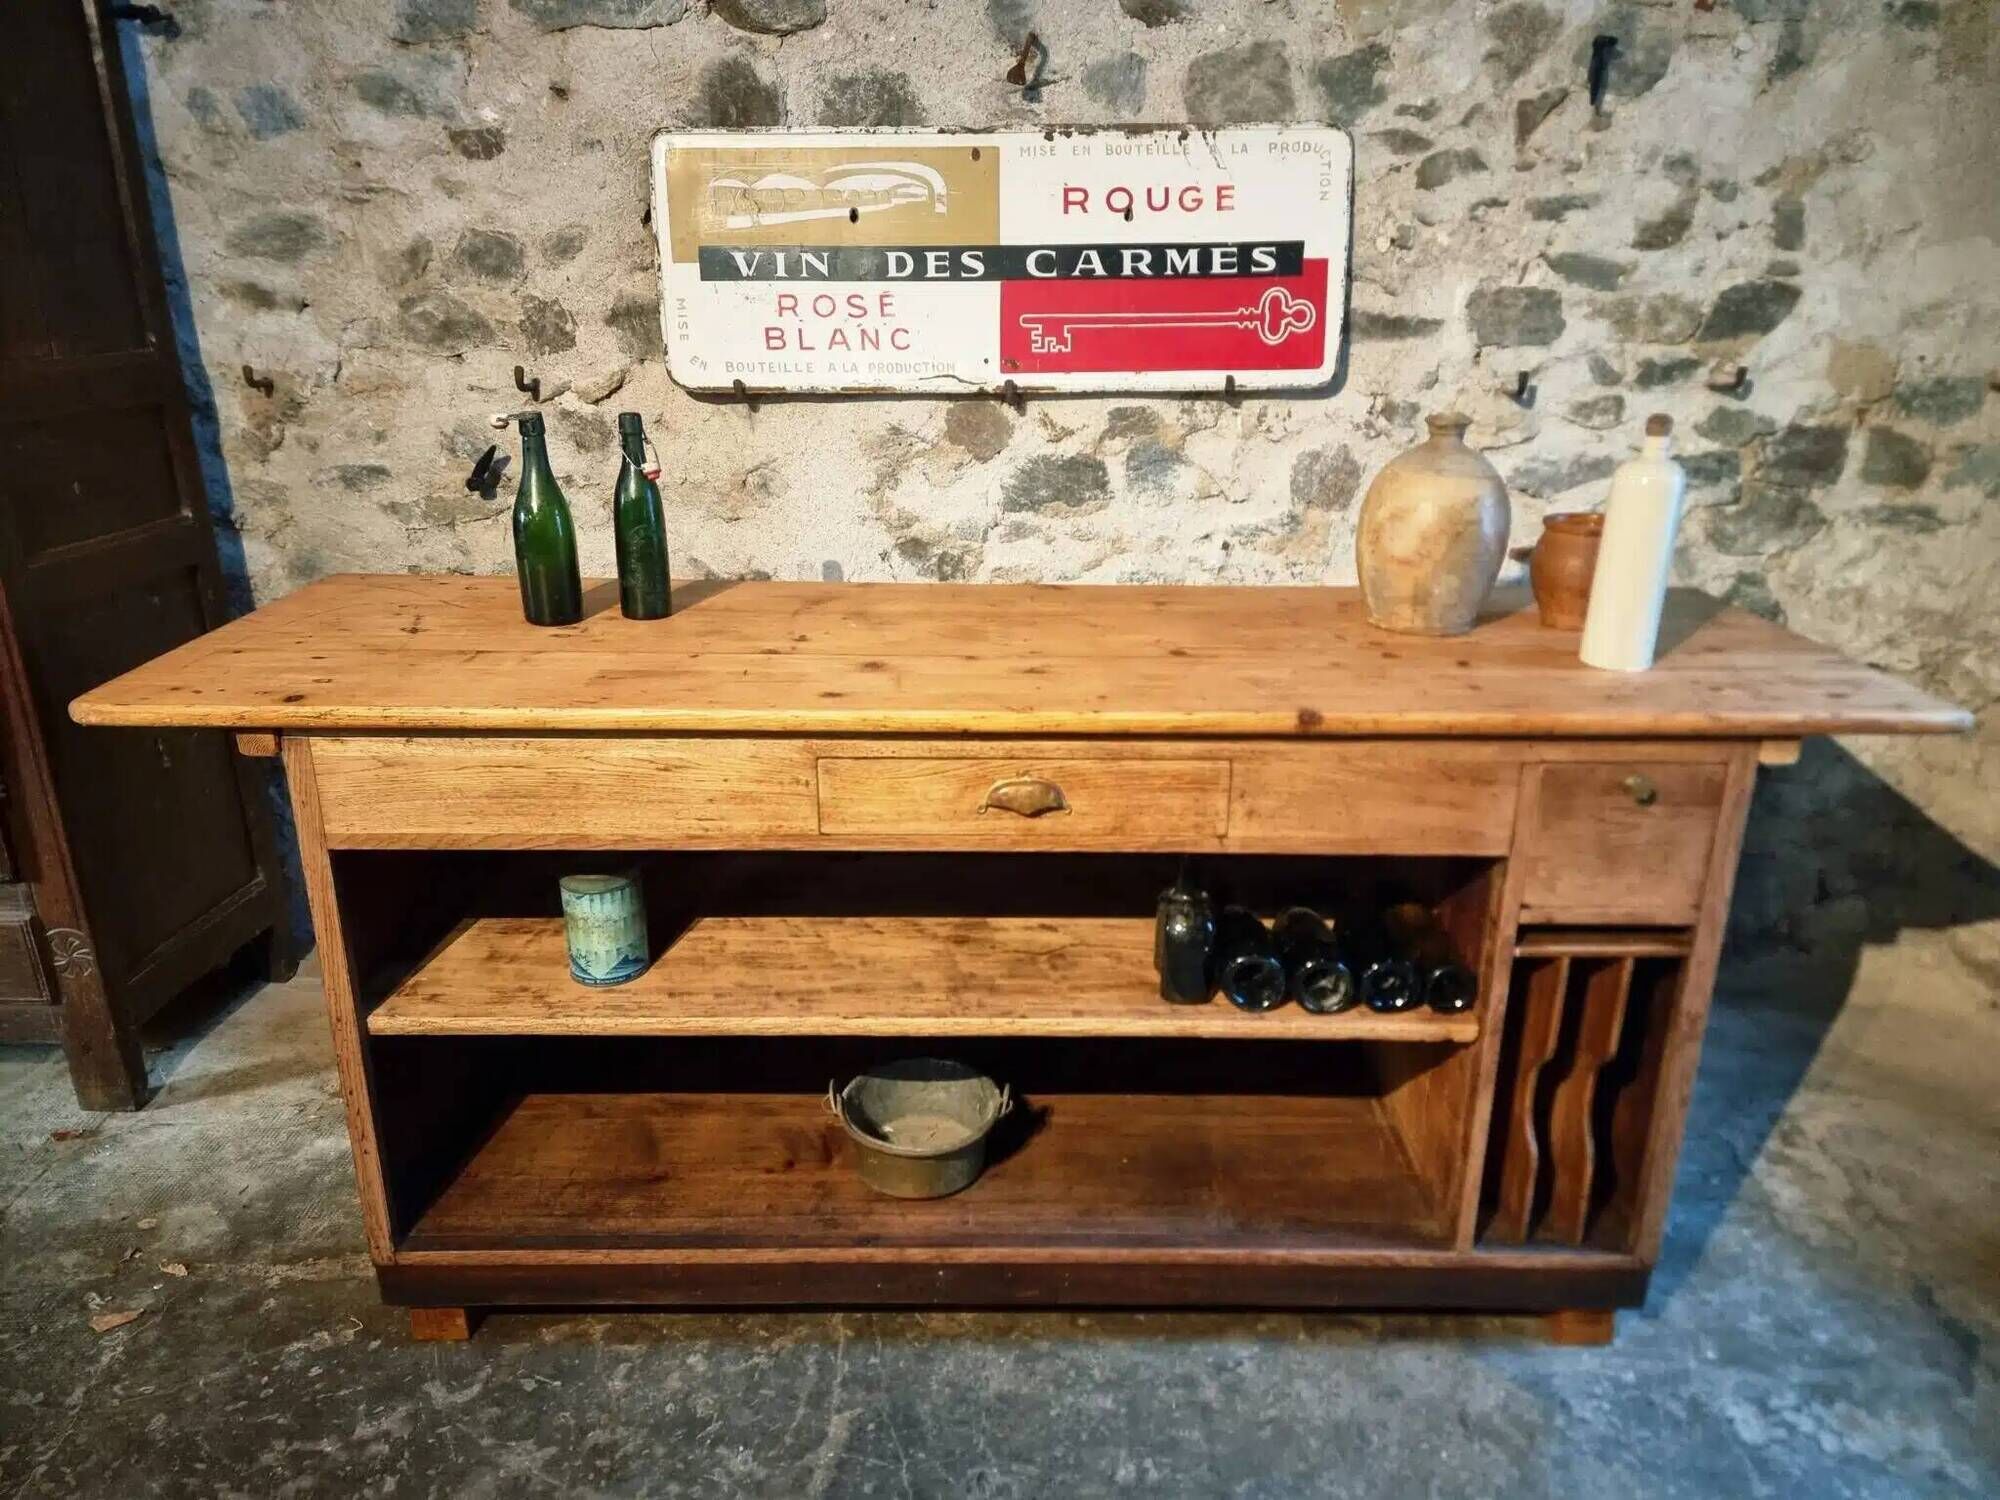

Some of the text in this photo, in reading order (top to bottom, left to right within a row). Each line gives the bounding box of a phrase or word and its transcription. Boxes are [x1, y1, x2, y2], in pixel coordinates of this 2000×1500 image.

[1020, 144, 1056, 157] MISE
[1073, 144, 1091, 156] EN
[1105, 143, 1190, 156] BOUTEILLE
[1231, 143, 1248, 155] LA
[1063, 185, 1236, 214] ROUGE
[729, 246, 1278, 278] VIN DES CARMES
[777, 291, 897, 318] ROSÉ
[676, 298, 689, 341] MISE
[689, 355, 708, 371] EN
[725, 361, 814, 373] BOUTEILLE
[868, 361, 956, 374] PRODUCTION
[764, 327, 912, 351] BLANC
